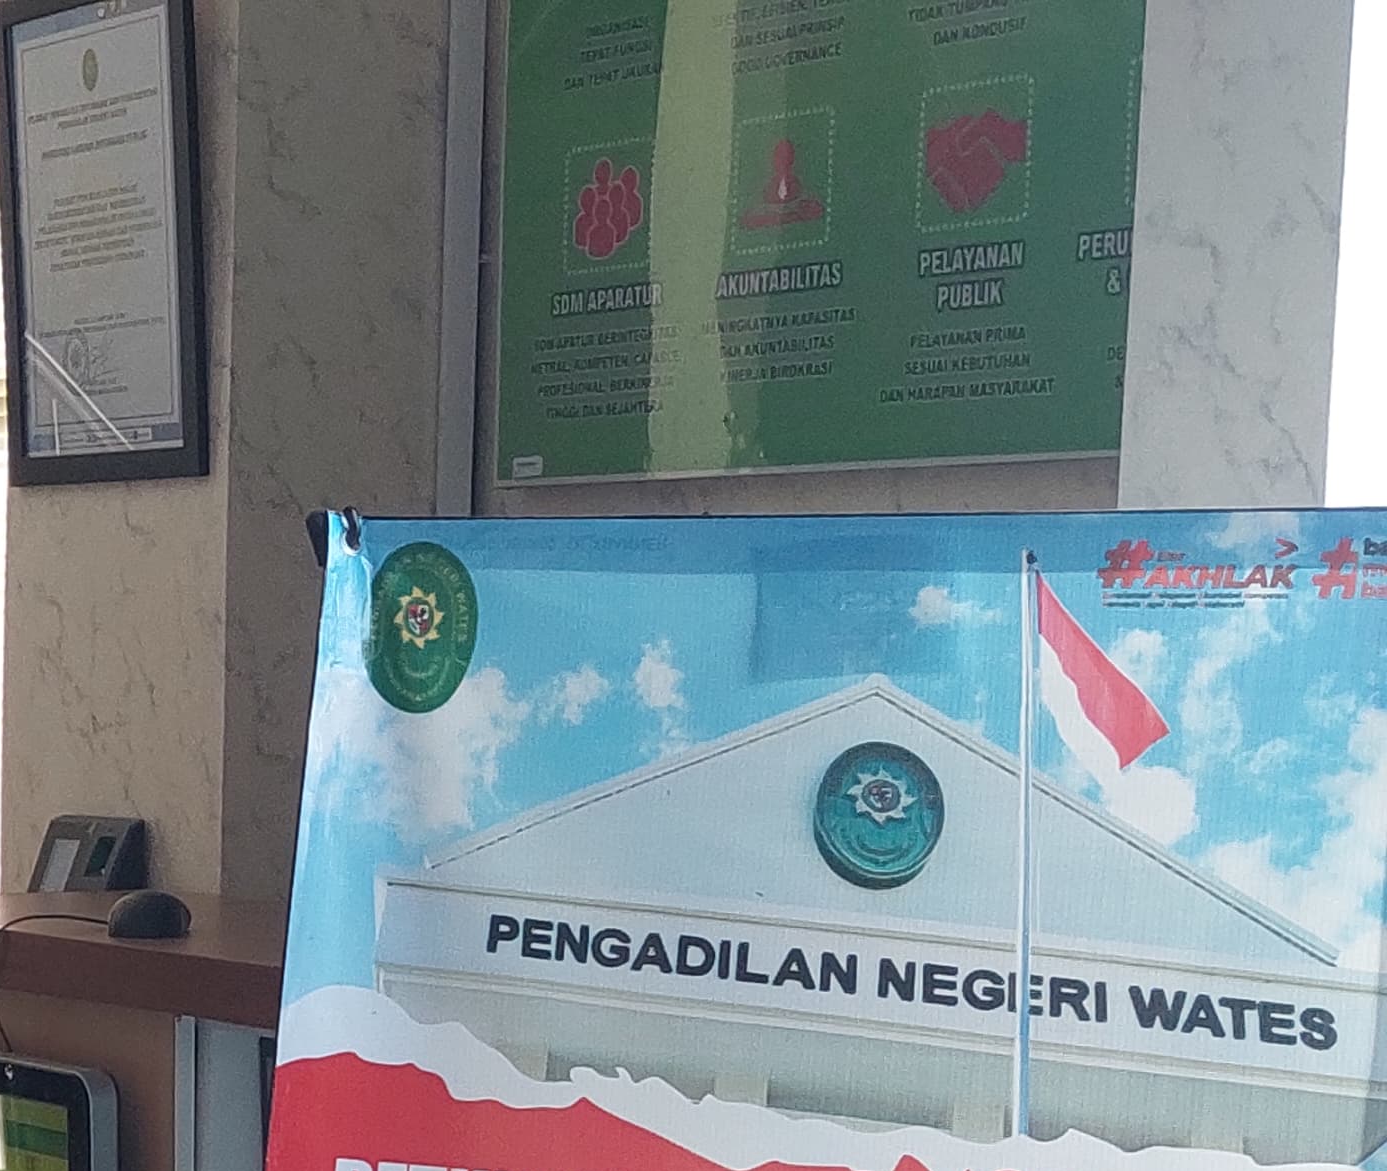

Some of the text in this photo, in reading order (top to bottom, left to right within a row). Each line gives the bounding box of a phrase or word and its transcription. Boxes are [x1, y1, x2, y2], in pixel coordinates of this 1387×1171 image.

[919, 241, 1024, 275] PELAYANAN
[715, 263, 842, 299] AKUNTABILITAS
[937, 281, 1004, 310] PUBLIK
[552, 283, 663, 316] SDM APARATUR
[485, 914, 1339, 1052] PENGADILAN NEGERI WATES
